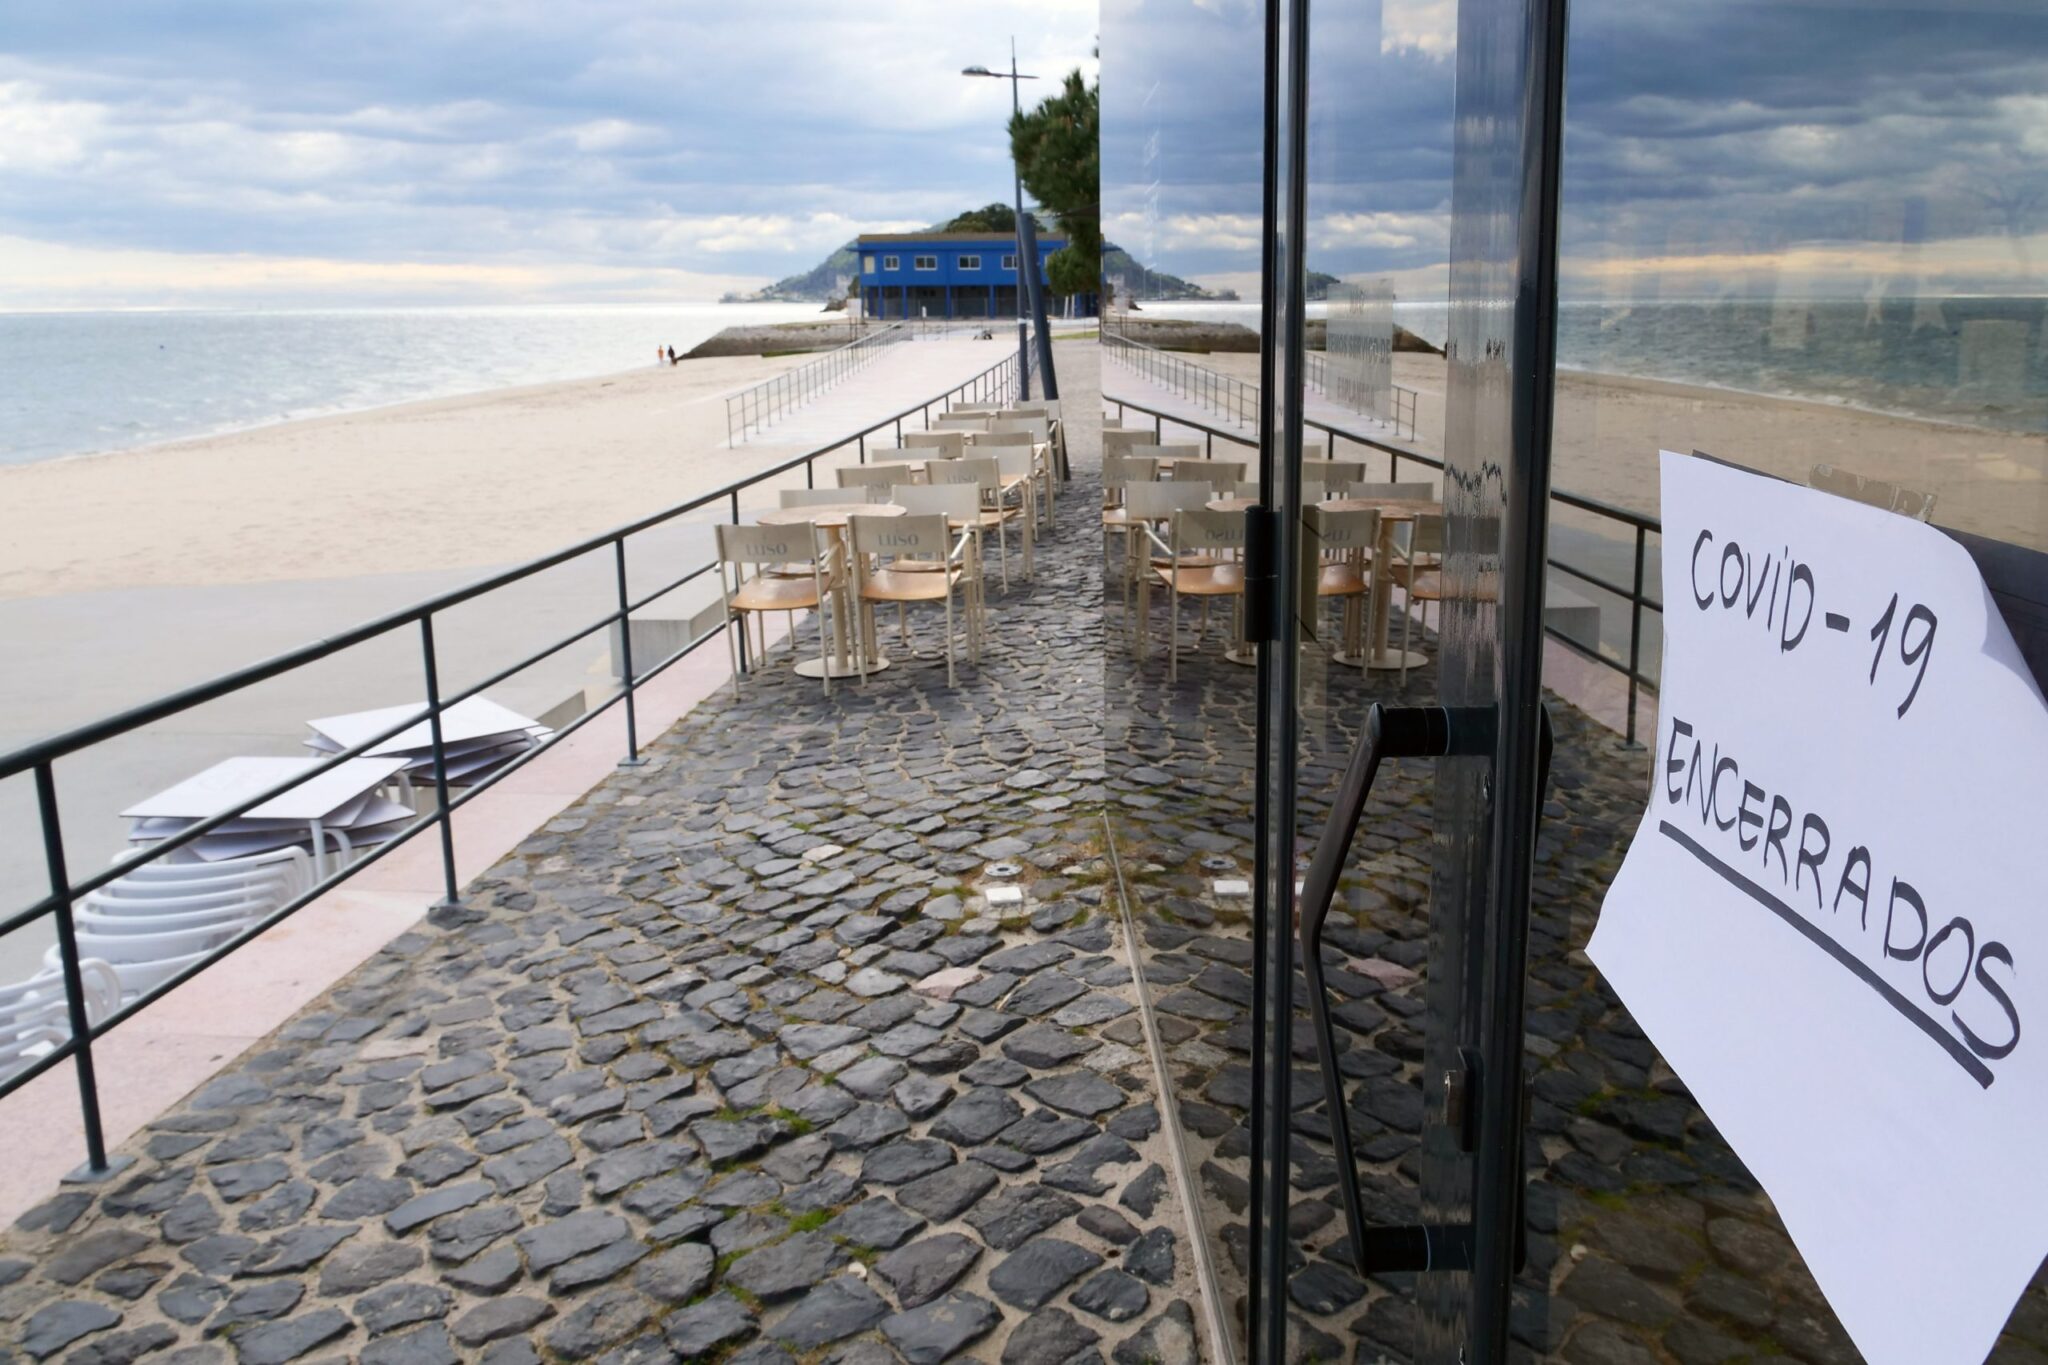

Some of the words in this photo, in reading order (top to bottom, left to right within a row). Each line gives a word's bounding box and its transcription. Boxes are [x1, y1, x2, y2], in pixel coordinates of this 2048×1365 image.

[878, 533, 919, 546] LUSO
[746, 543, 788, 556] LUSO
[1665, 716, 2021, 1060] ENCERRADOS
